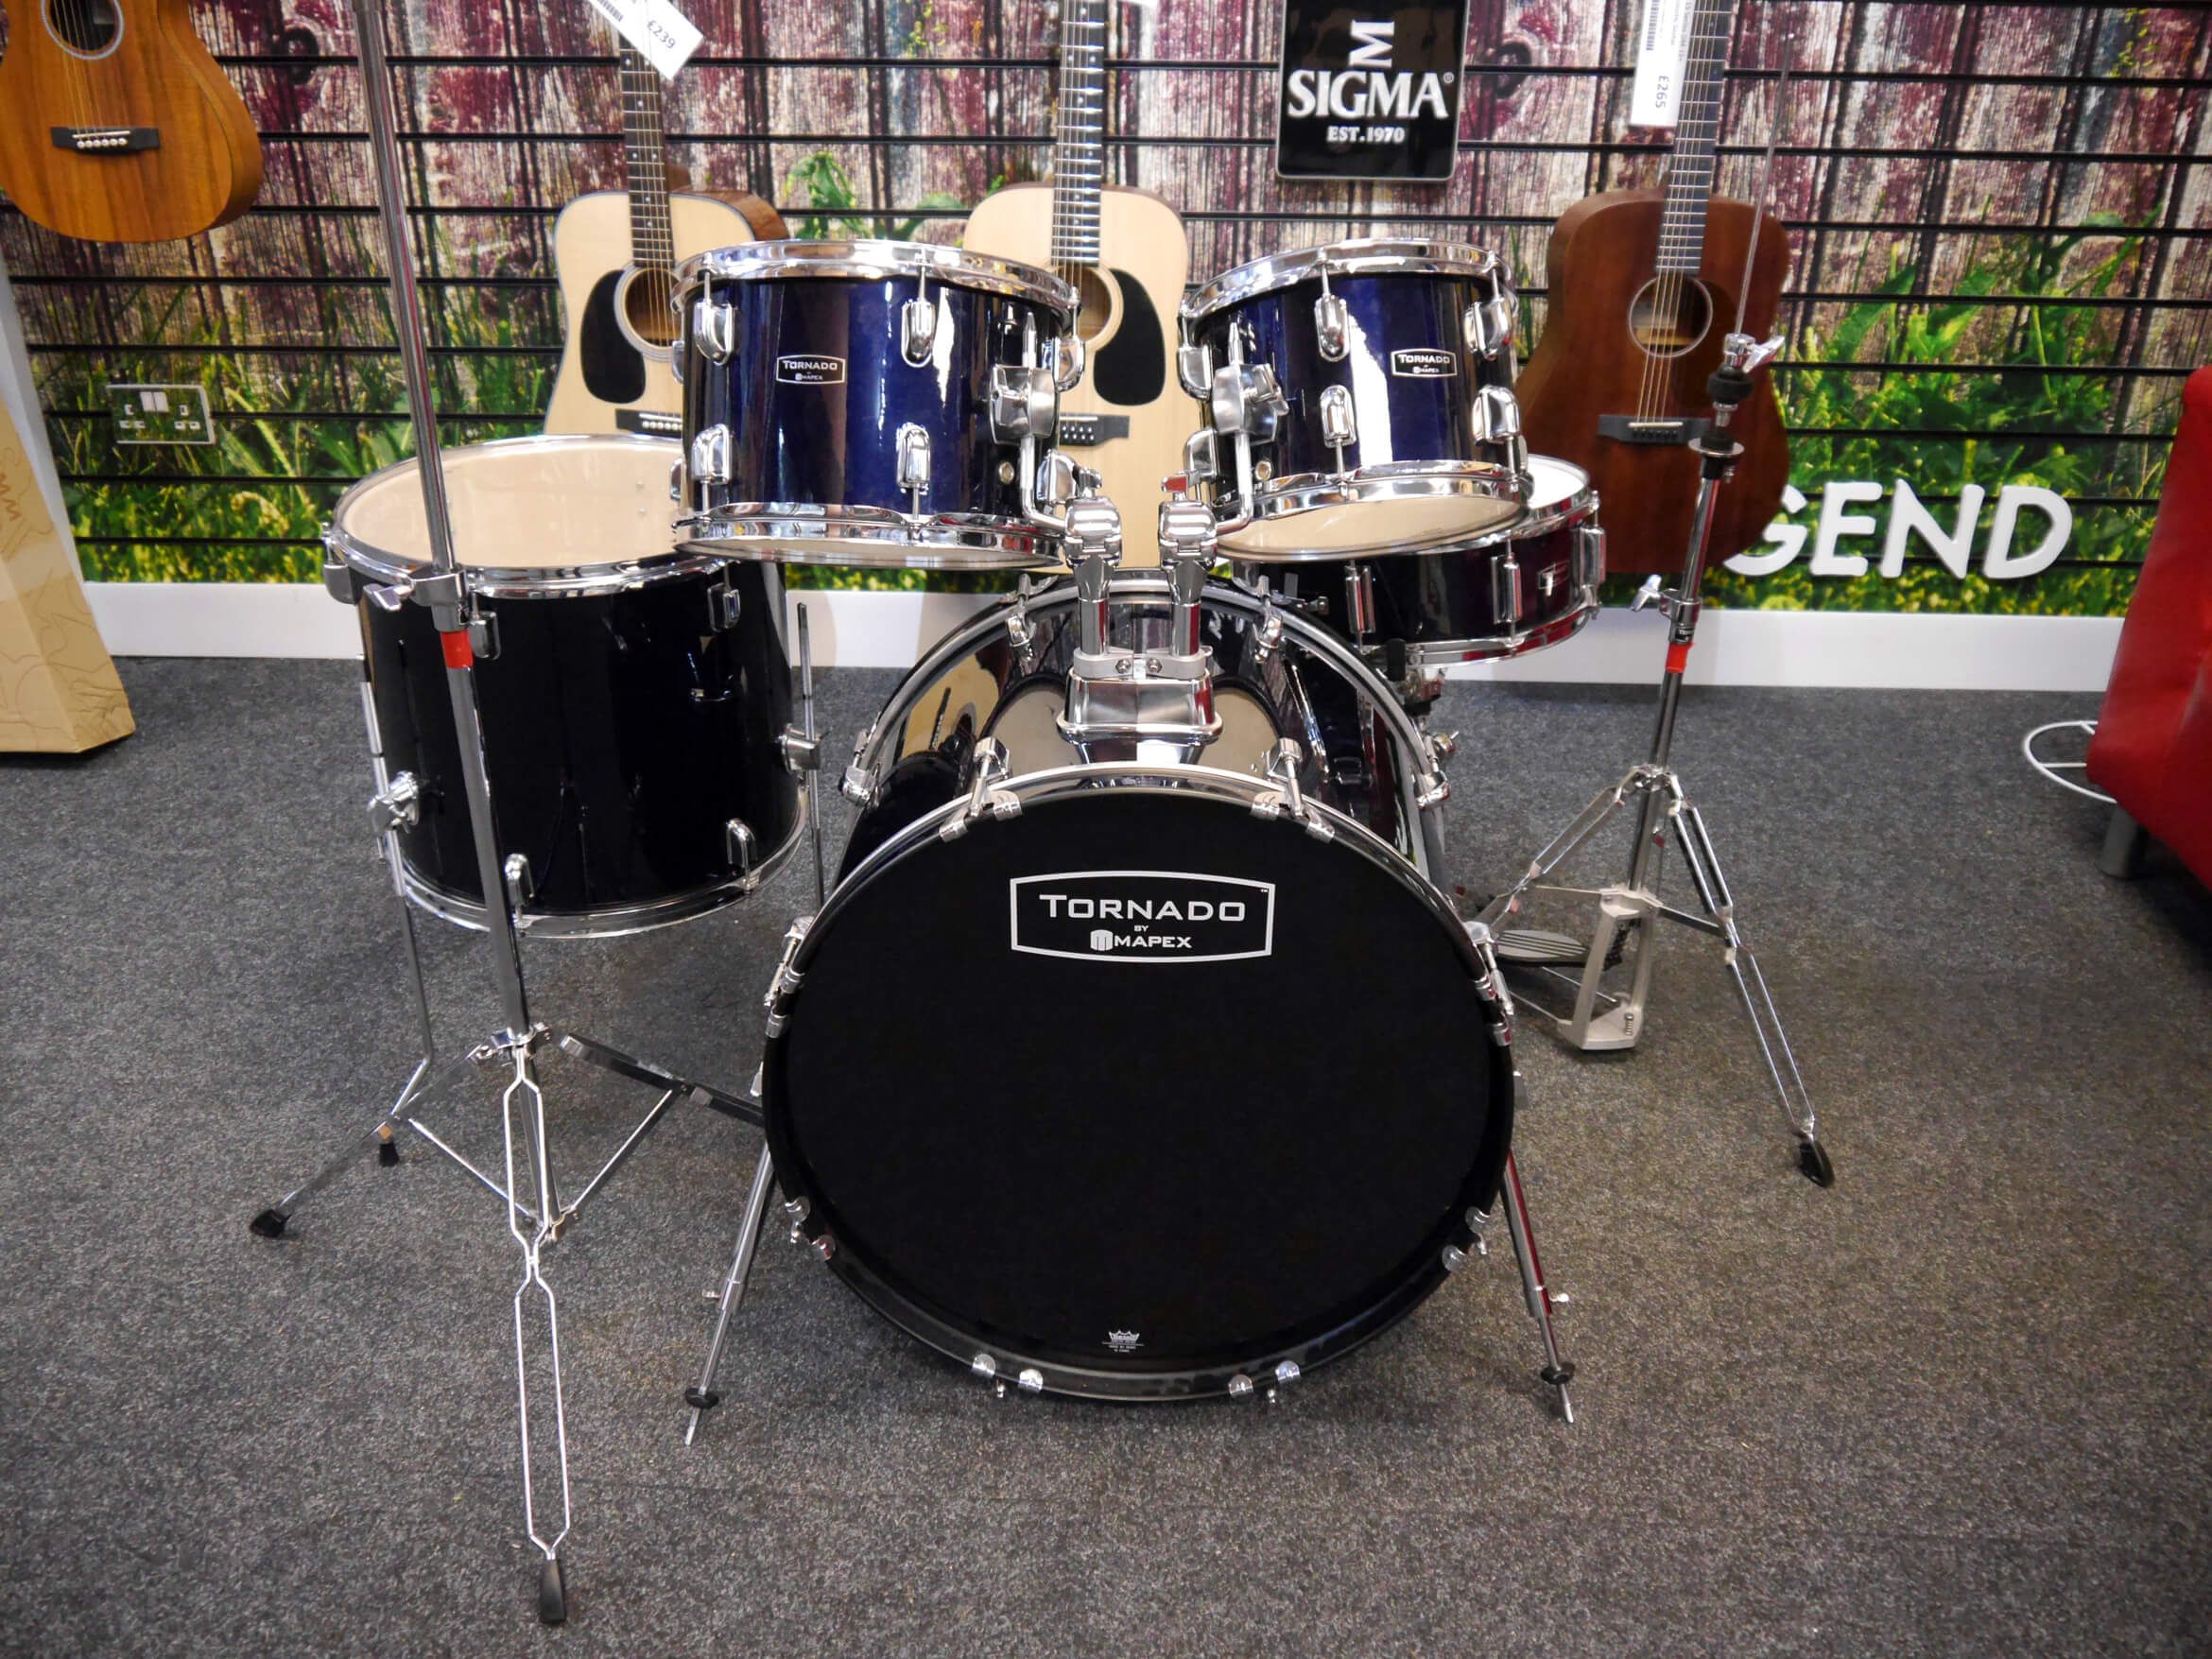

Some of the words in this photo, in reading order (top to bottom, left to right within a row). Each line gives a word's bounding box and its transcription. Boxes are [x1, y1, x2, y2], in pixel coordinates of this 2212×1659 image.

[1398, 354, 1450, 363] TORNADO
[782, 360, 838, 371] TORNADO
[1039, 894, 1246, 922] TORNADO
[1114, 935, 1193, 948] MAPEX
